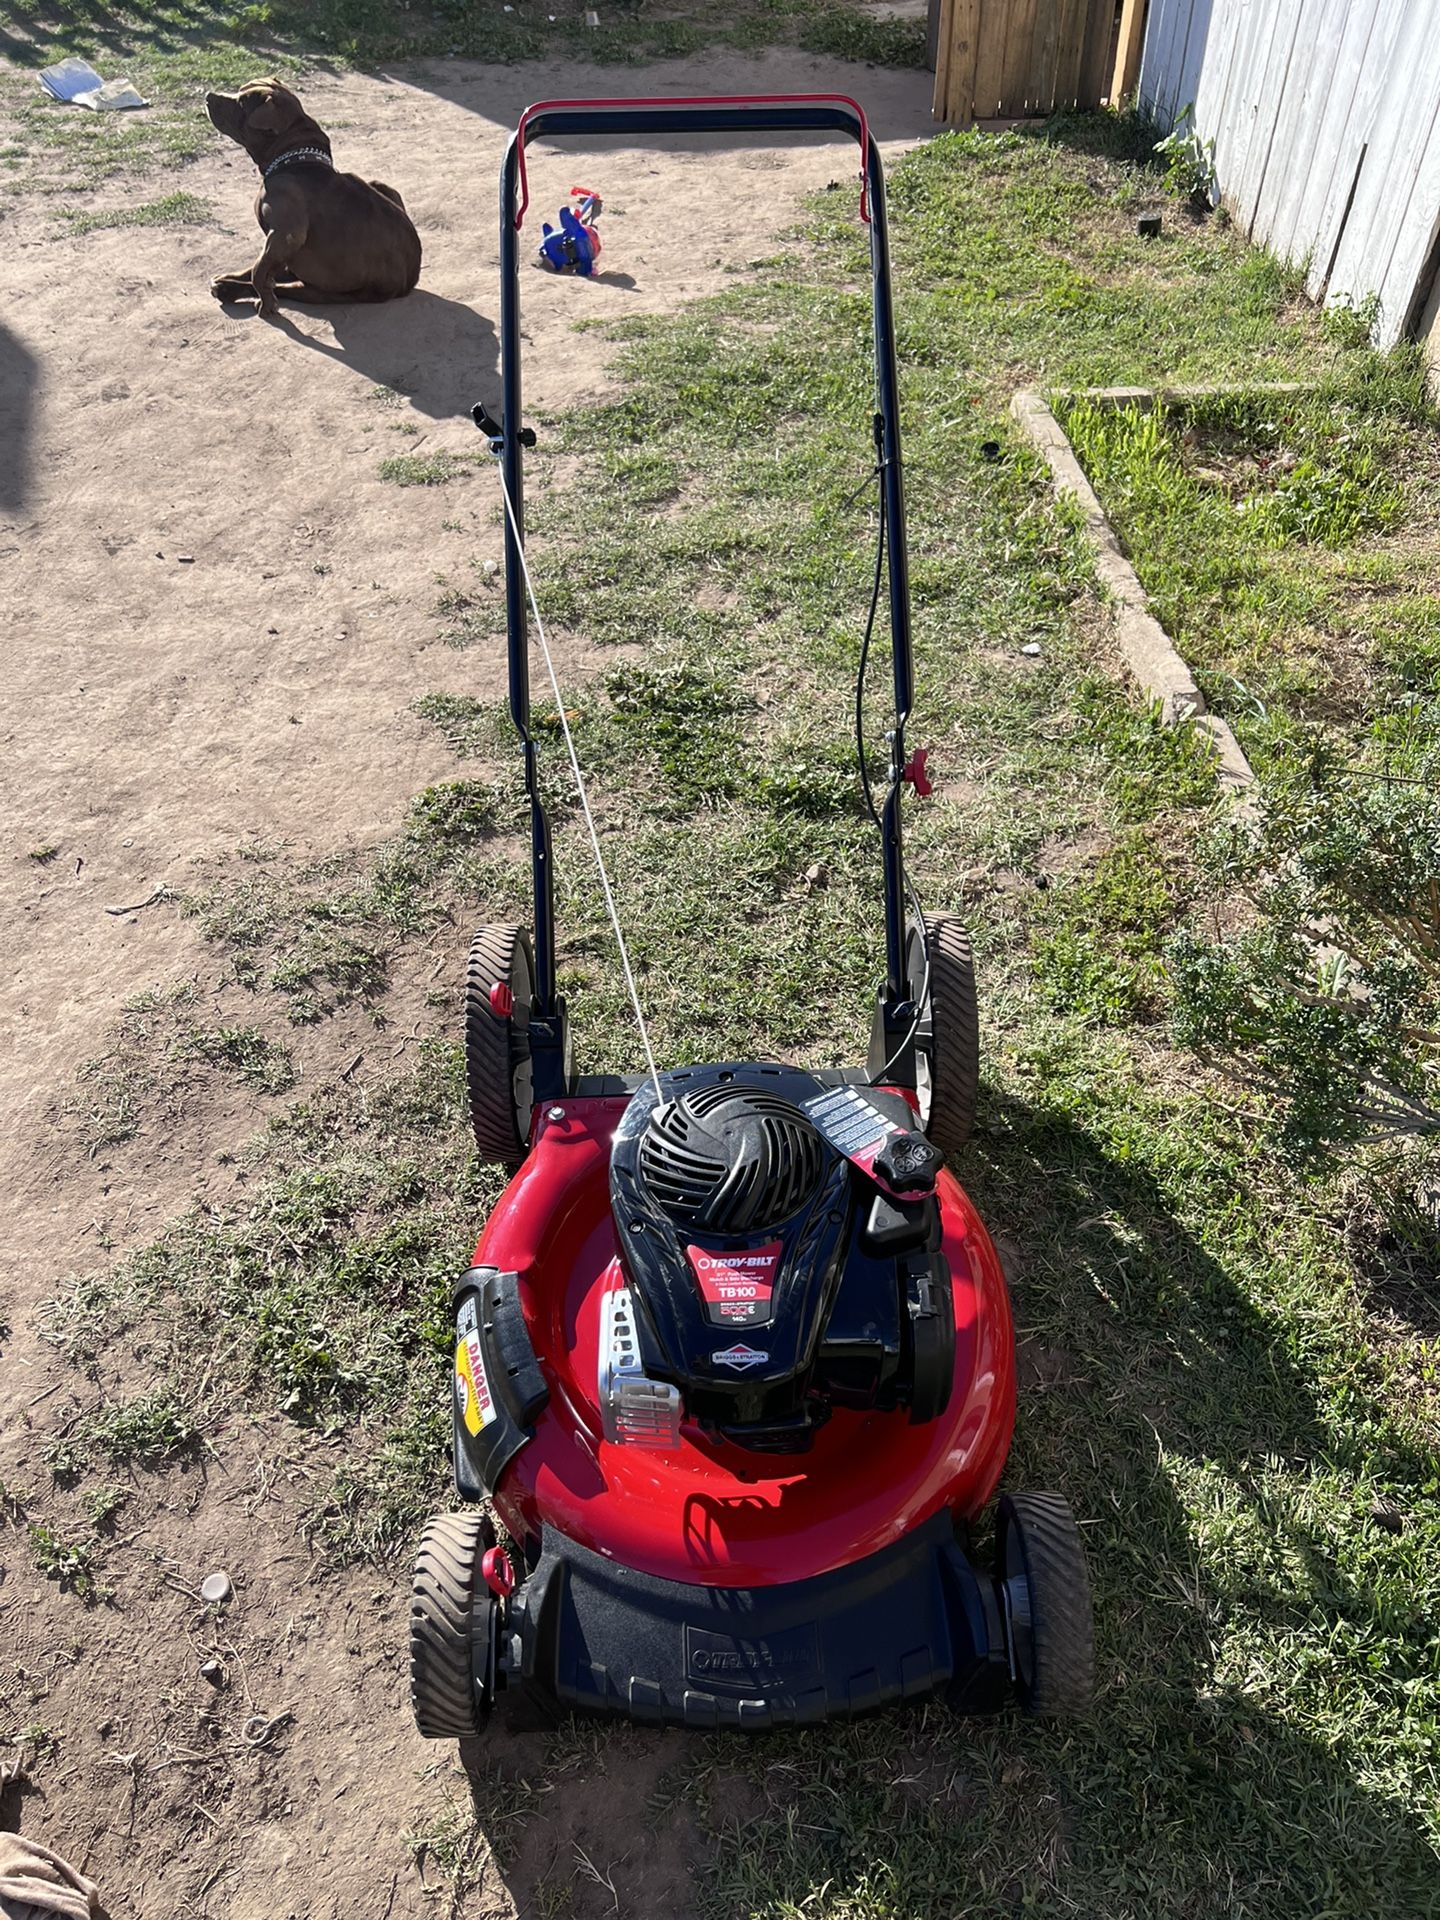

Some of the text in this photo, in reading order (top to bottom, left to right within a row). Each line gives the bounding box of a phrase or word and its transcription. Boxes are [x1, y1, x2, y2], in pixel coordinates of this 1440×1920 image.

[711, 1256, 774, 1268] TROY-BILT
[719, 1287, 756, 1298] TB100
[469, 1342, 490, 1411] DANGER
